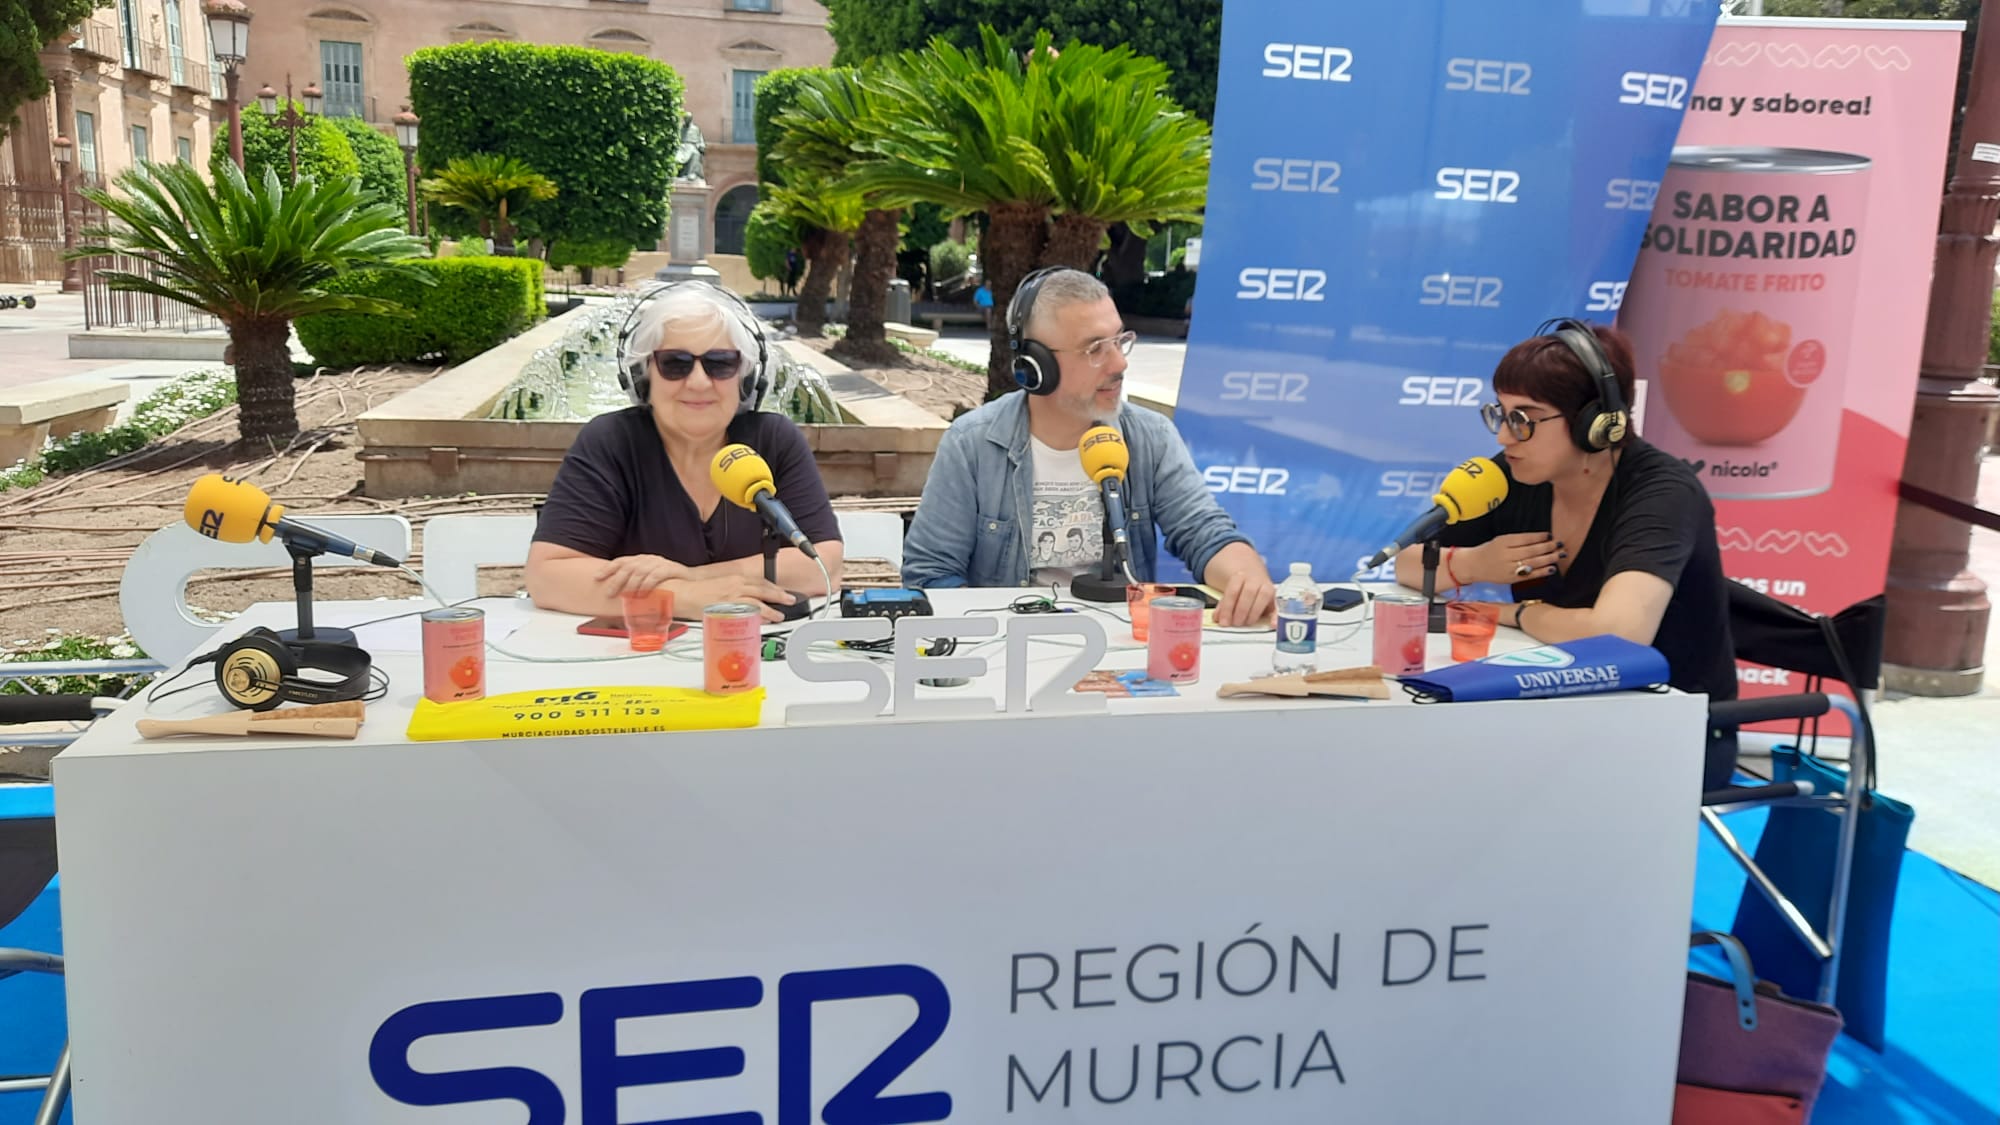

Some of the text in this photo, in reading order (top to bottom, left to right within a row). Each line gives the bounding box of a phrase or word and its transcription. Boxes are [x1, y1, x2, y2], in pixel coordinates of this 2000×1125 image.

[1262, 43, 1353, 82] SER
[1445, 58, 1532, 95] SER
[1618, 71, 1688, 110] SER
[1728, 94, 1746, 117] y
[1752, 92, 1872, 116] saborea!
[1251, 157, 1341, 194] SER
[1434, 167, 1520, 204] SER
[1672, 190, 1831, 224] SABOR A
[1236, 266, 1328, 302] SER
[1418, 274, 1503, 308] SER
[1664, 268, 1826, 293] TOMATE FRITO
[1220, 371, 1309, 402] SER
[1398, 375, 1484, 407] SER
[1203, 465, 1290, 496] SER
[1772, 580, 1806, 596] un
[785, 614, 1109, 727] SER
[1514, 664, 1621, 689] UNIVERSAE
[513, 707, 661, 721] 900 511 133
[502, 725, 666, 739] MURCIACIUDADSOSTENIBLE.ES
[1010, 922, 1490, 1014] REGIÓN DE
[368, 963, 953, 1125] SER
[1006, 1029, 1347, 1114] MURCIA
